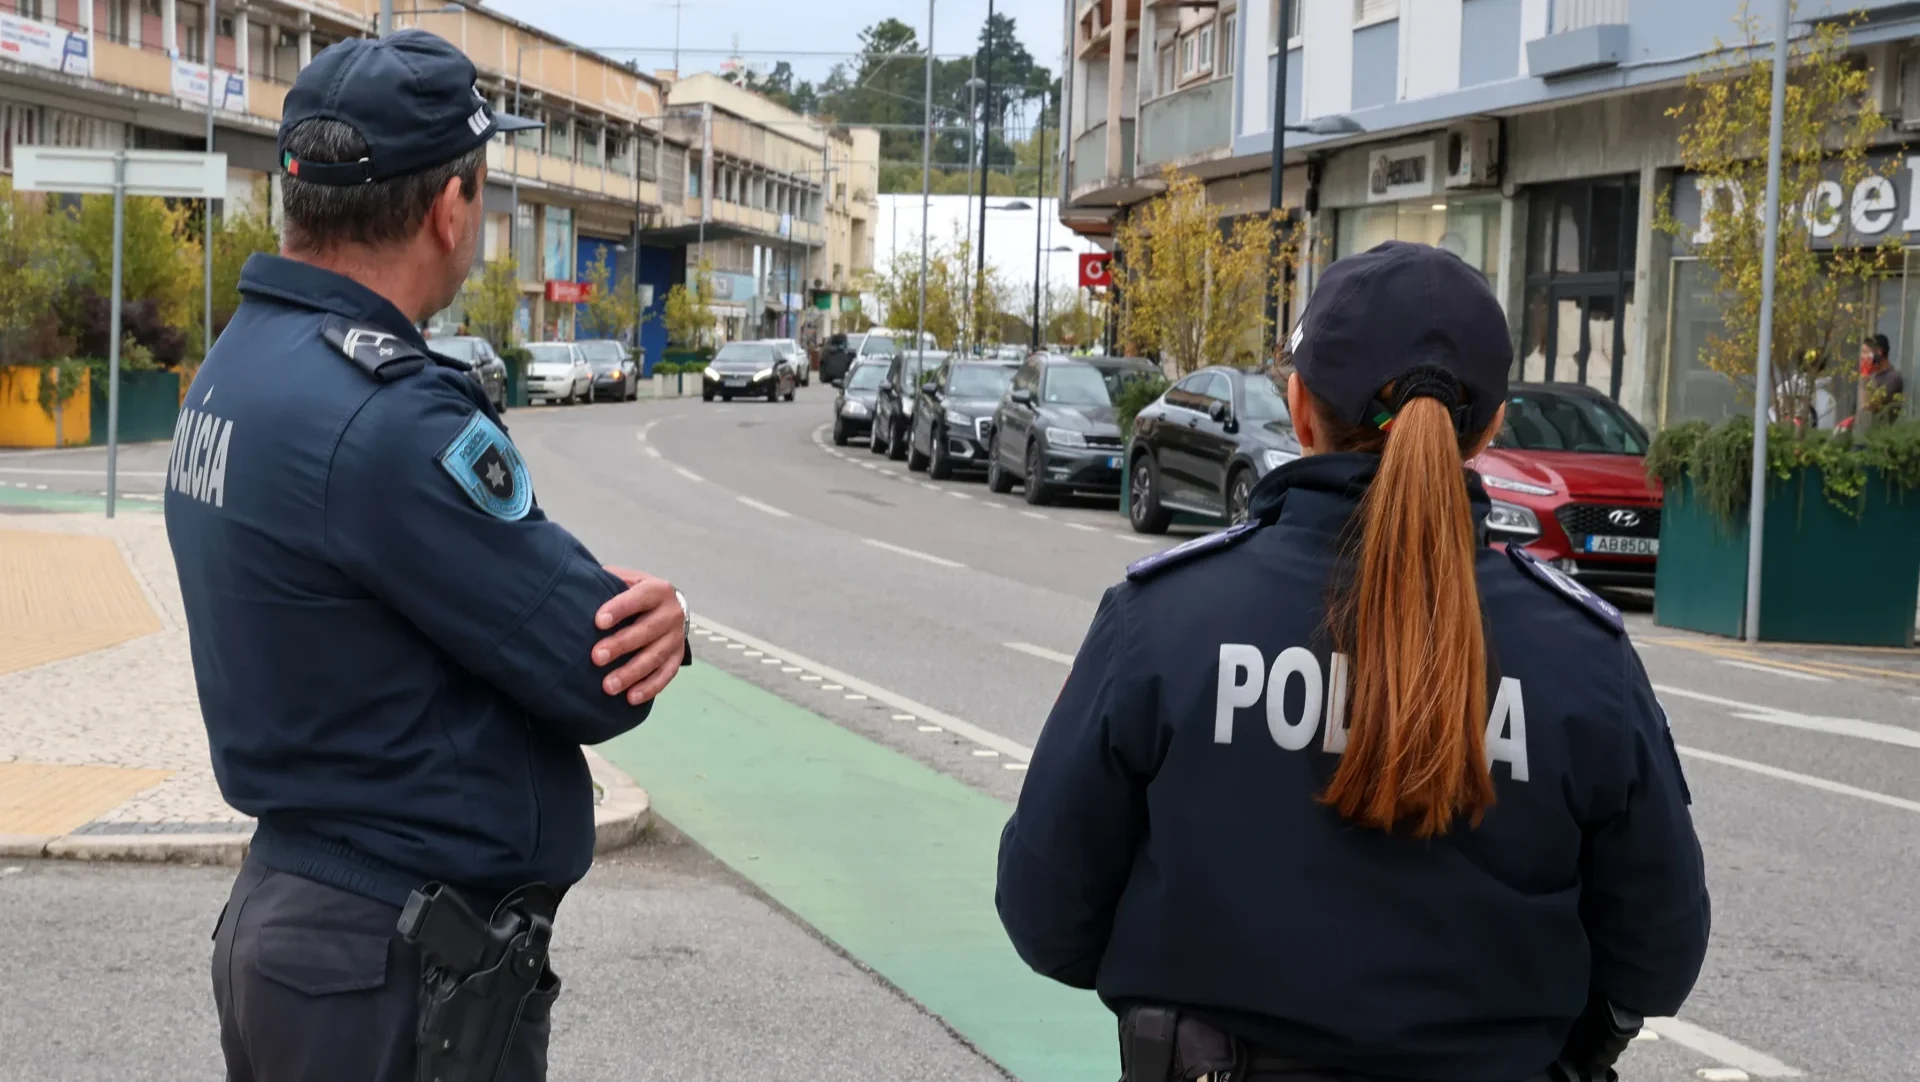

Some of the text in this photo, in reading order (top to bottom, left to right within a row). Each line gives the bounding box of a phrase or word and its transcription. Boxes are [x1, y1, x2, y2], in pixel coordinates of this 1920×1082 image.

[1692, 156, 1920, 244] Dcel
[170, 384, 234, 508] OLÍCIA
[1214, 643, 1530, 782] POLA
